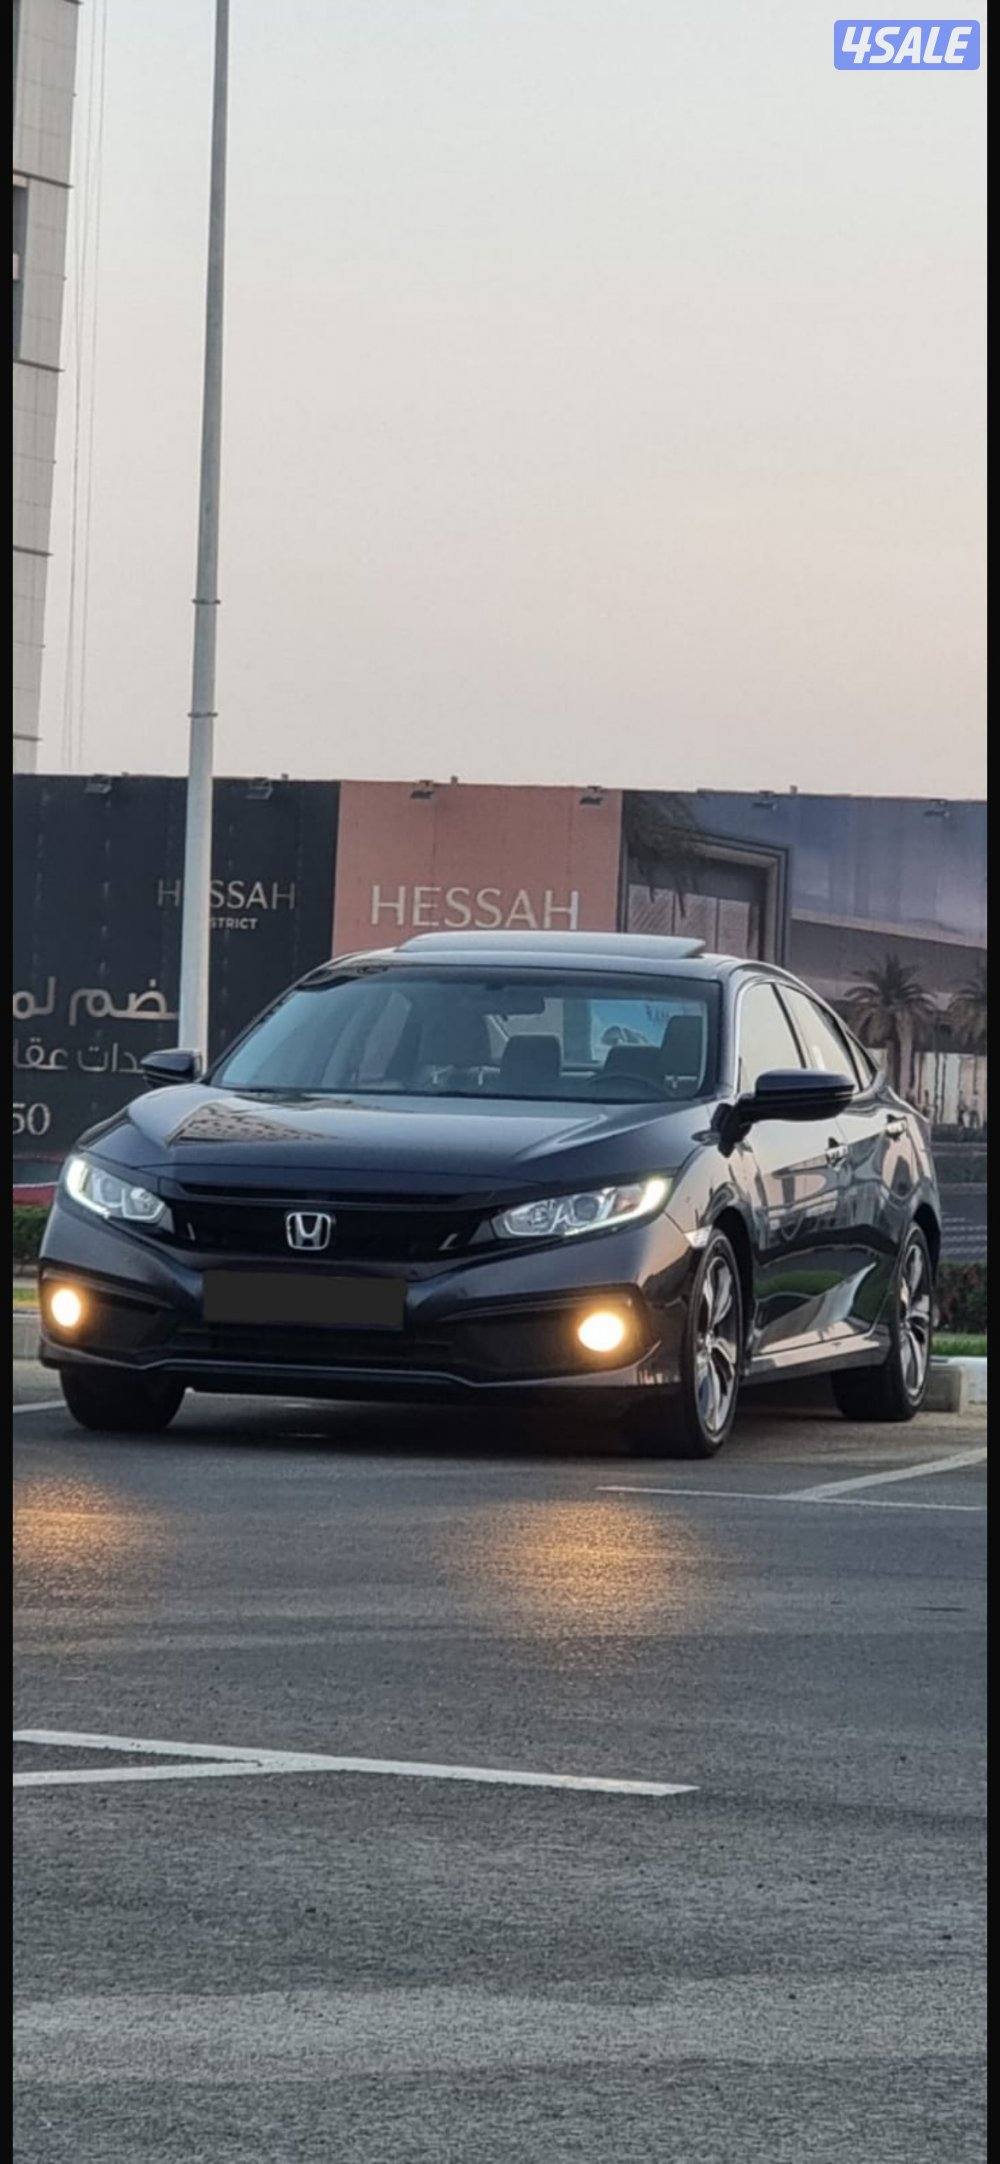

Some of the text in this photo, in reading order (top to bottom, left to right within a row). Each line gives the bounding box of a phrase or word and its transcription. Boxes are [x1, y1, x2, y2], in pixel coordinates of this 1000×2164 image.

[157, 879, 296, 910] HSSAH
[371, 885, 579, 930] HESSAH
[69, 978, 179, 1026] ضم
[77, 1042, 145, 1074] دات
